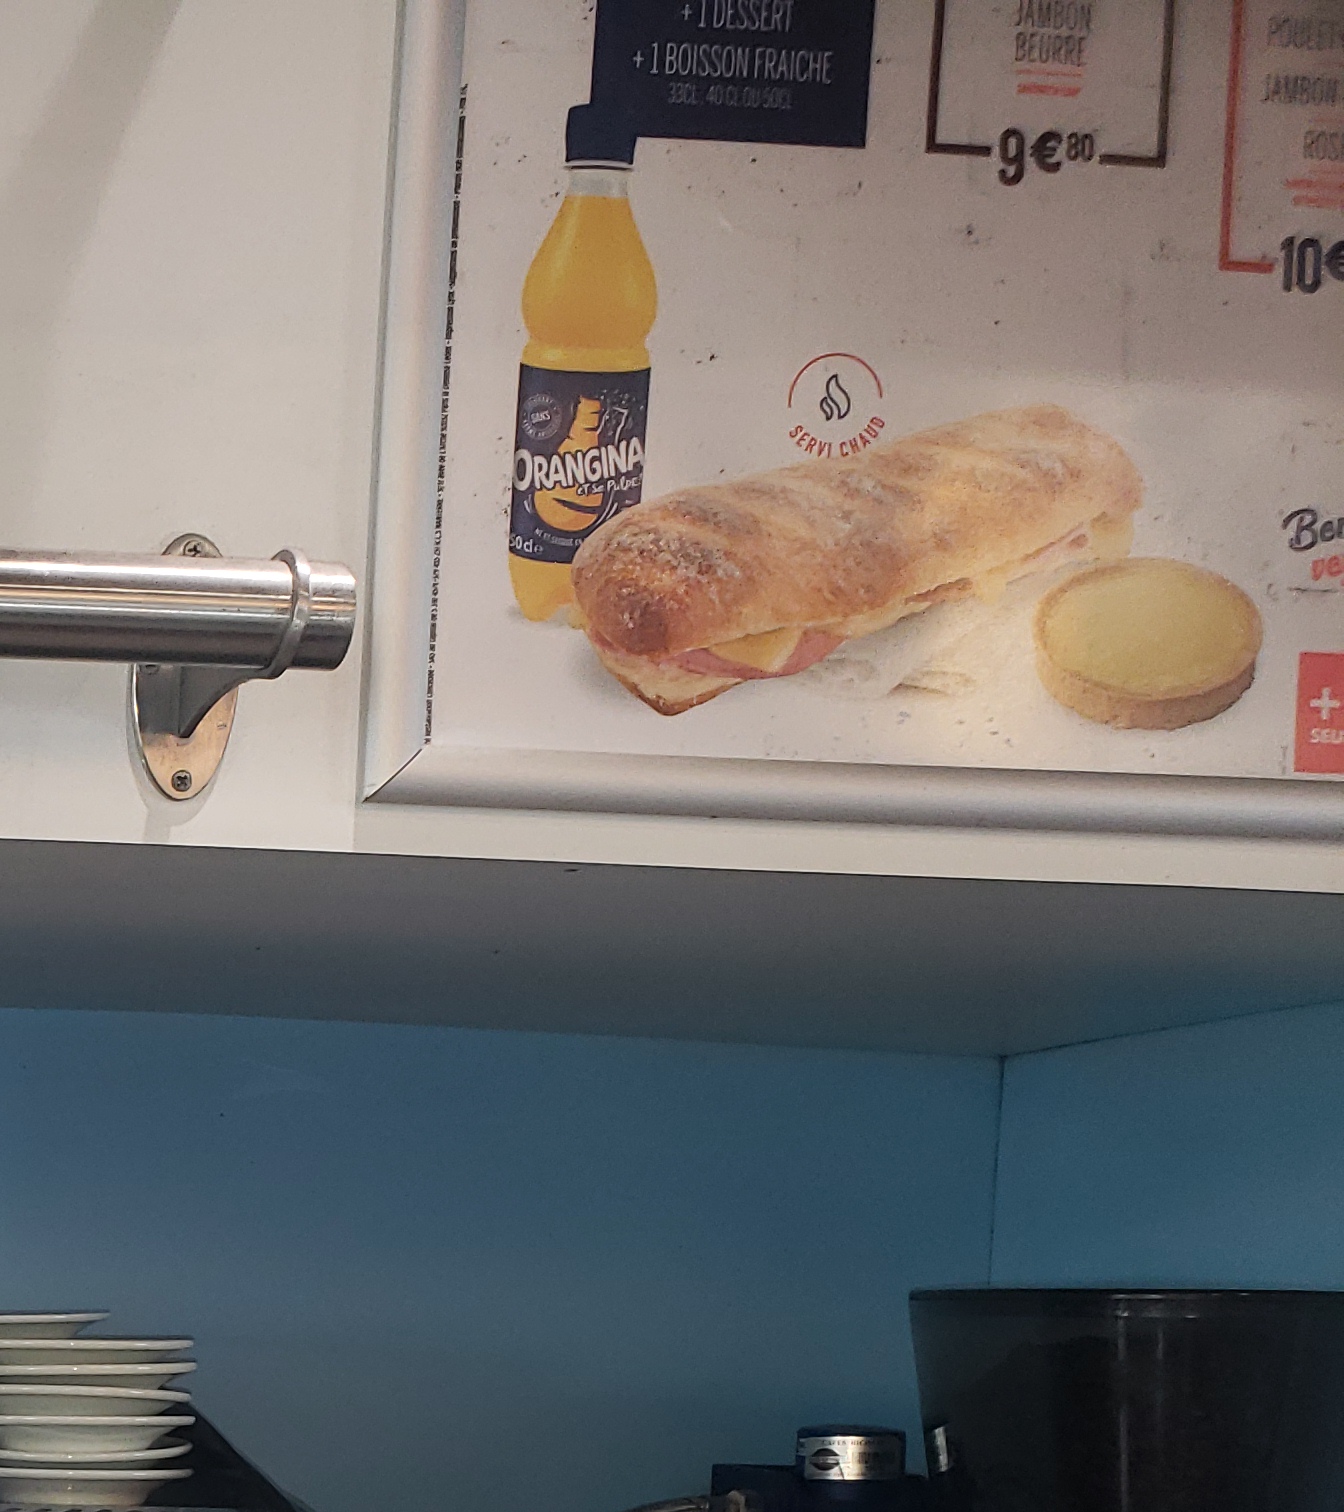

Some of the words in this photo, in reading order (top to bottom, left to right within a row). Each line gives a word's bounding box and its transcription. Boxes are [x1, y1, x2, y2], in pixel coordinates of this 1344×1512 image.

[713, 0, 794, 33] DESSERT
[1014, 0, 1092, 31] JAMBON
[650, 43, 659, 75] 1
[666, 43, 748, 79] BOISSON
[754, 48, 834, 85] FRAICHE
[1015, 31, 1087, 67] BEURRE
[1303, 130, 1344, 161] ROS
[789, 425, 832, 459] SERVI
[839, 416, 886, 458] CHAUD
[512, 437, 646, 491] ORANGINA
